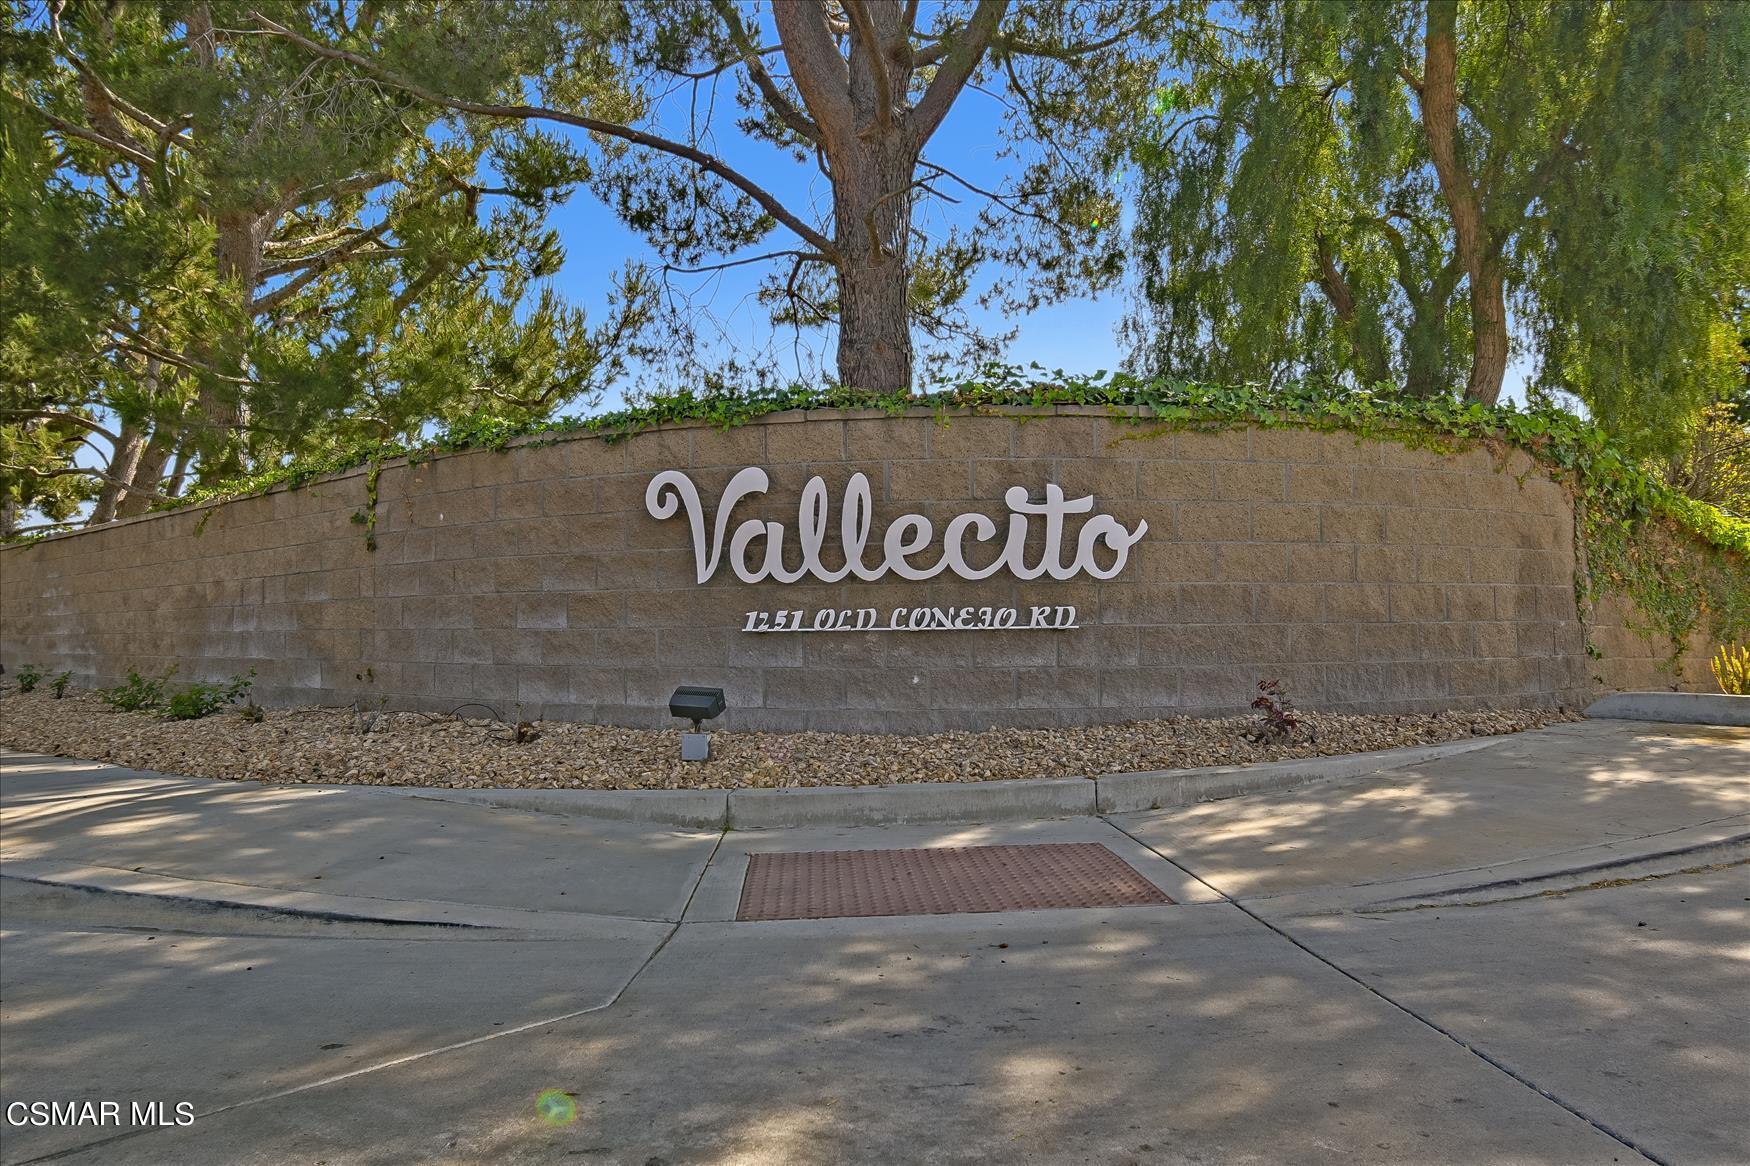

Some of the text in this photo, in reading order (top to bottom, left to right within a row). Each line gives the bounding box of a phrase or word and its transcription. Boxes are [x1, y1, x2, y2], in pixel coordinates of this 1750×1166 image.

[646, 466, 1149, 585] Vallecito
[743, 605, 1077, 632] 1251 OLD CONEJO RD
